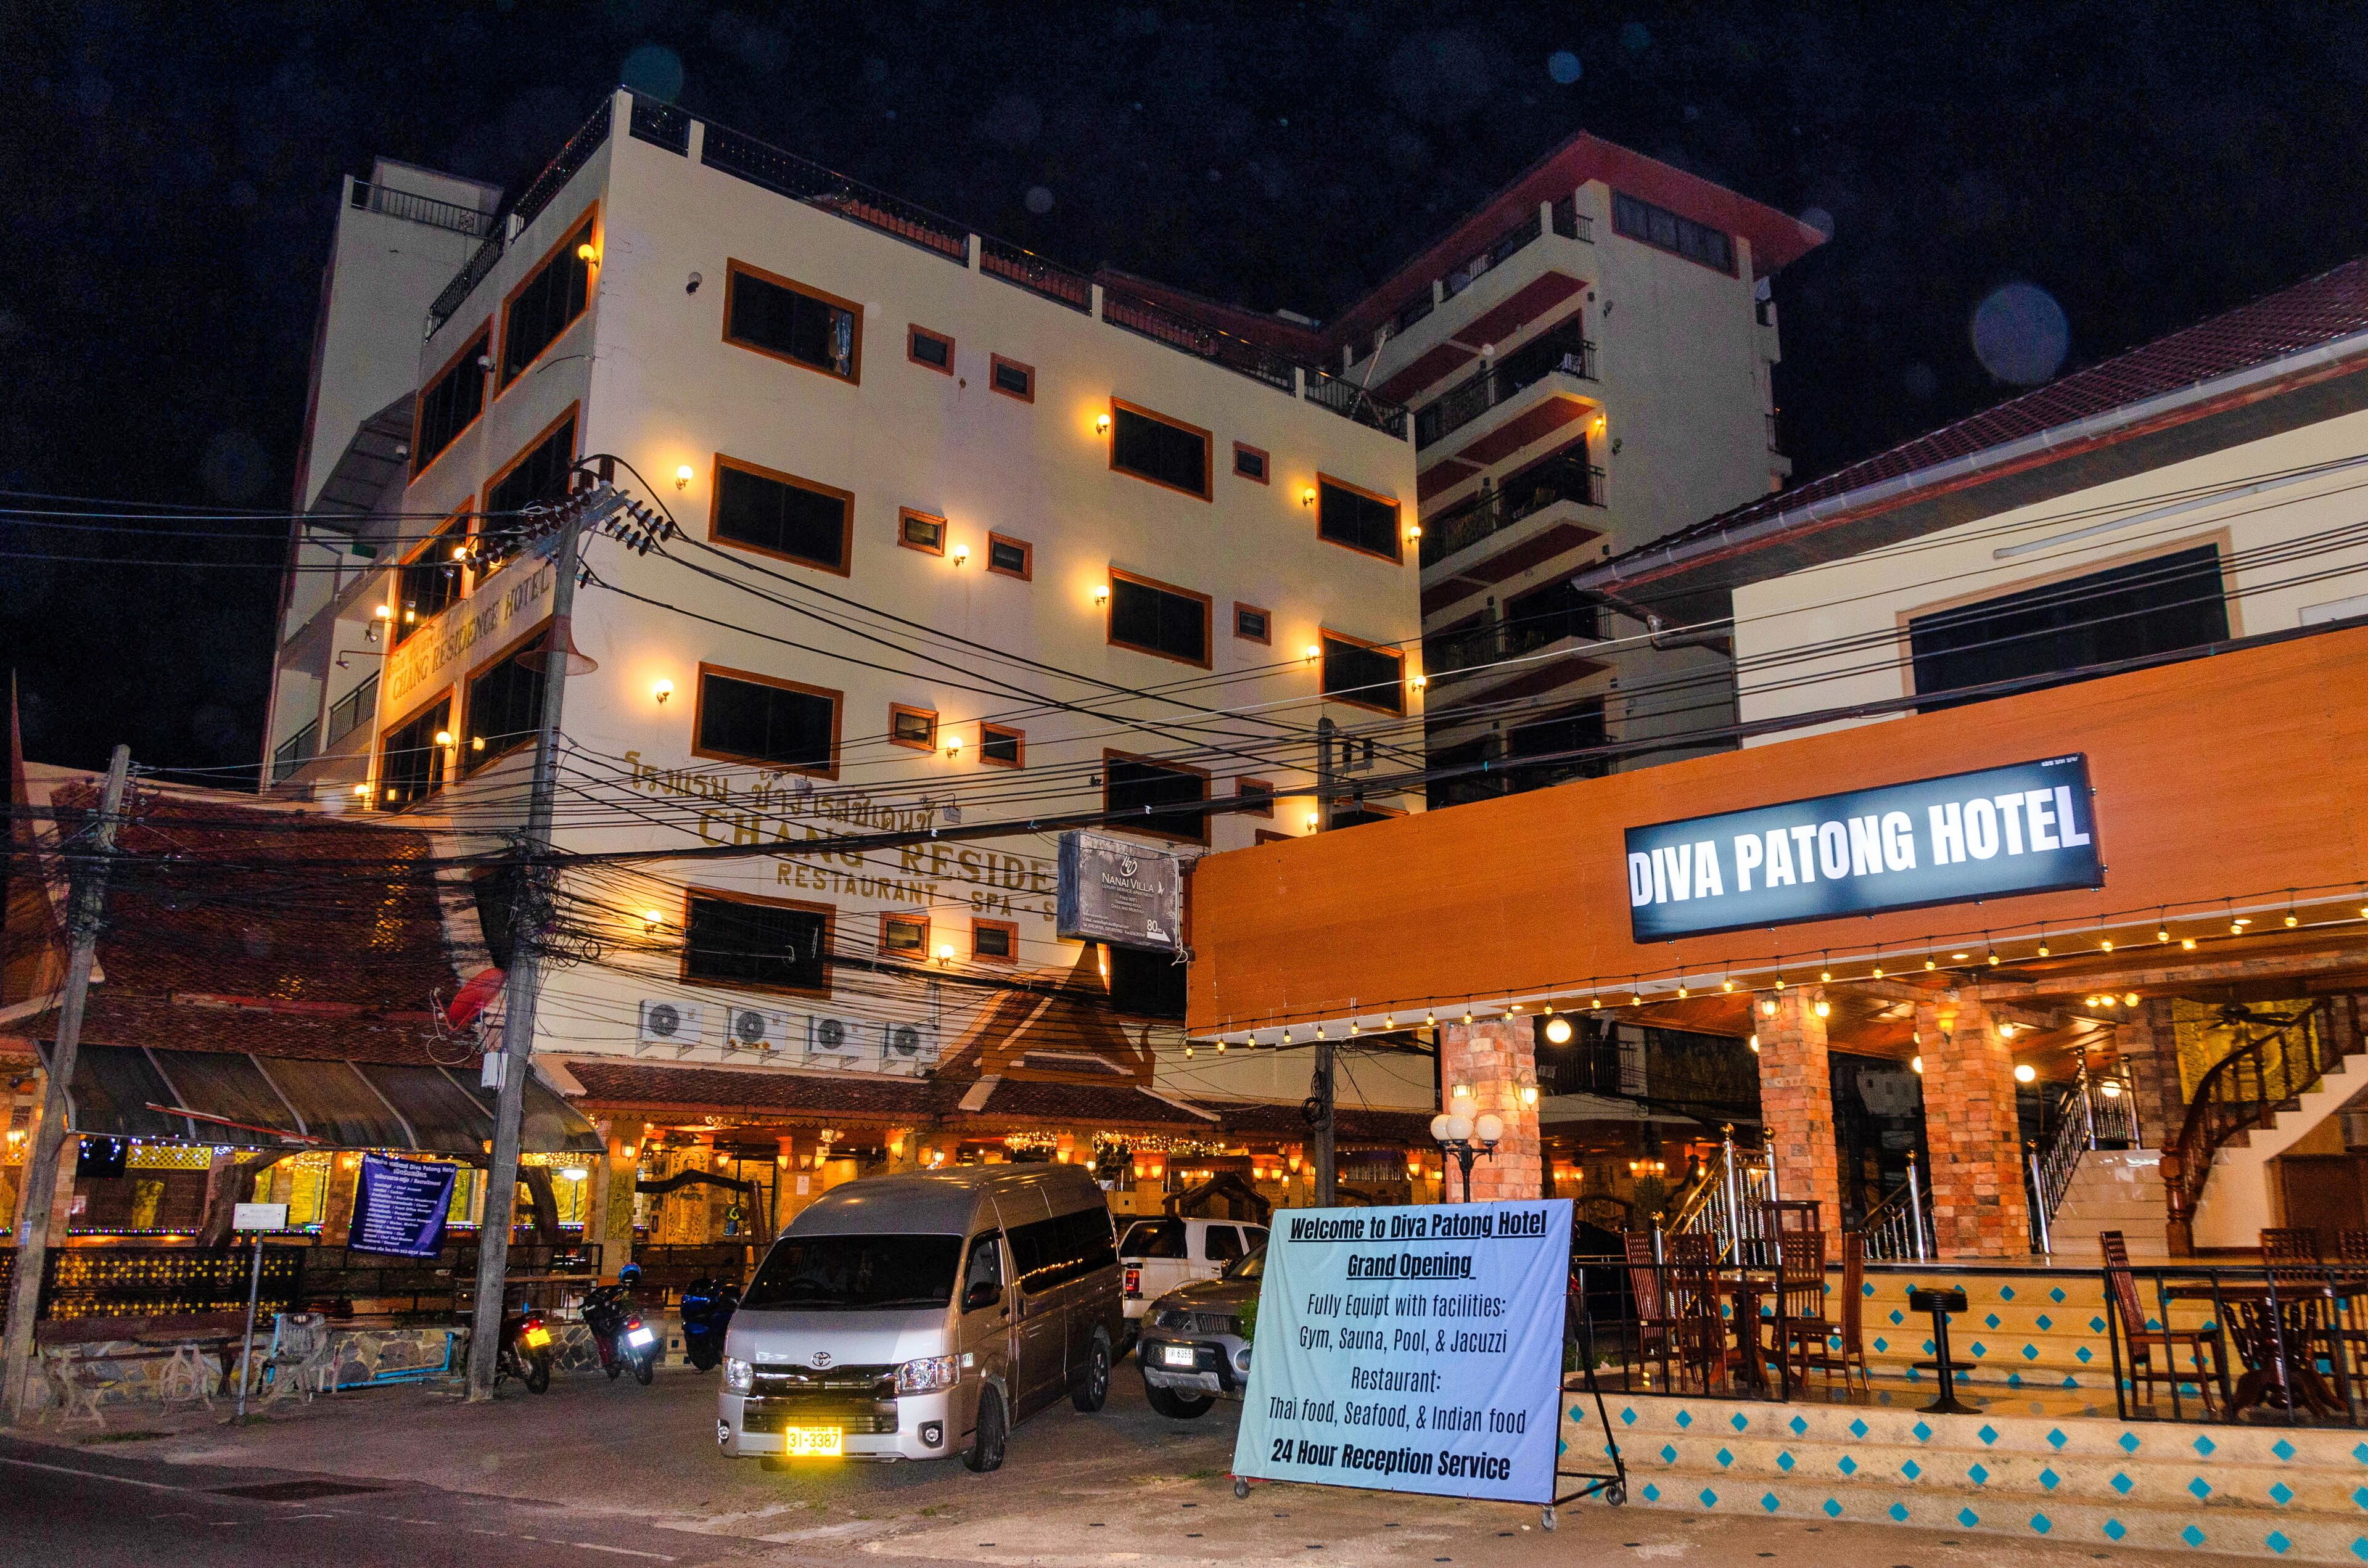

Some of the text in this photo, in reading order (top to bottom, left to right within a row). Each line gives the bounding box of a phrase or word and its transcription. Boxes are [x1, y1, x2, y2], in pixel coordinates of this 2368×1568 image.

[504, 567, 549, 621] HOTEL
[625, 750, 728, 803] โรงแรม
[1628, 785, 2090, 907] DIVA PATONG HOTEL
[777, 863, 937, 905] RESTAURANT
[971, 890, 1012, 916] SPA
[1102, 872, 1154, 893] NANAI VILLA
[1291, 1210, 1547, 1240] Welcome to Diva Patong Hotel
[1347, 1252, 1472, 1279] Grand Opening
[1307, 1293, 1505, 1318] Fully Equipt with facilities:
[1299, 1326, 1508, 1355] Gym, Sauna, Pool, & Jacuzzi
[1351, 1367, 1441, 1393] Restaurant:
[1270, 1397, 1526, 1434] Thai food, Seafood, & Indian food
[790, 1433, 839, 1448] 31-3387
[1271, 1439, 1511, 1479] 24 Hour Reception Service
